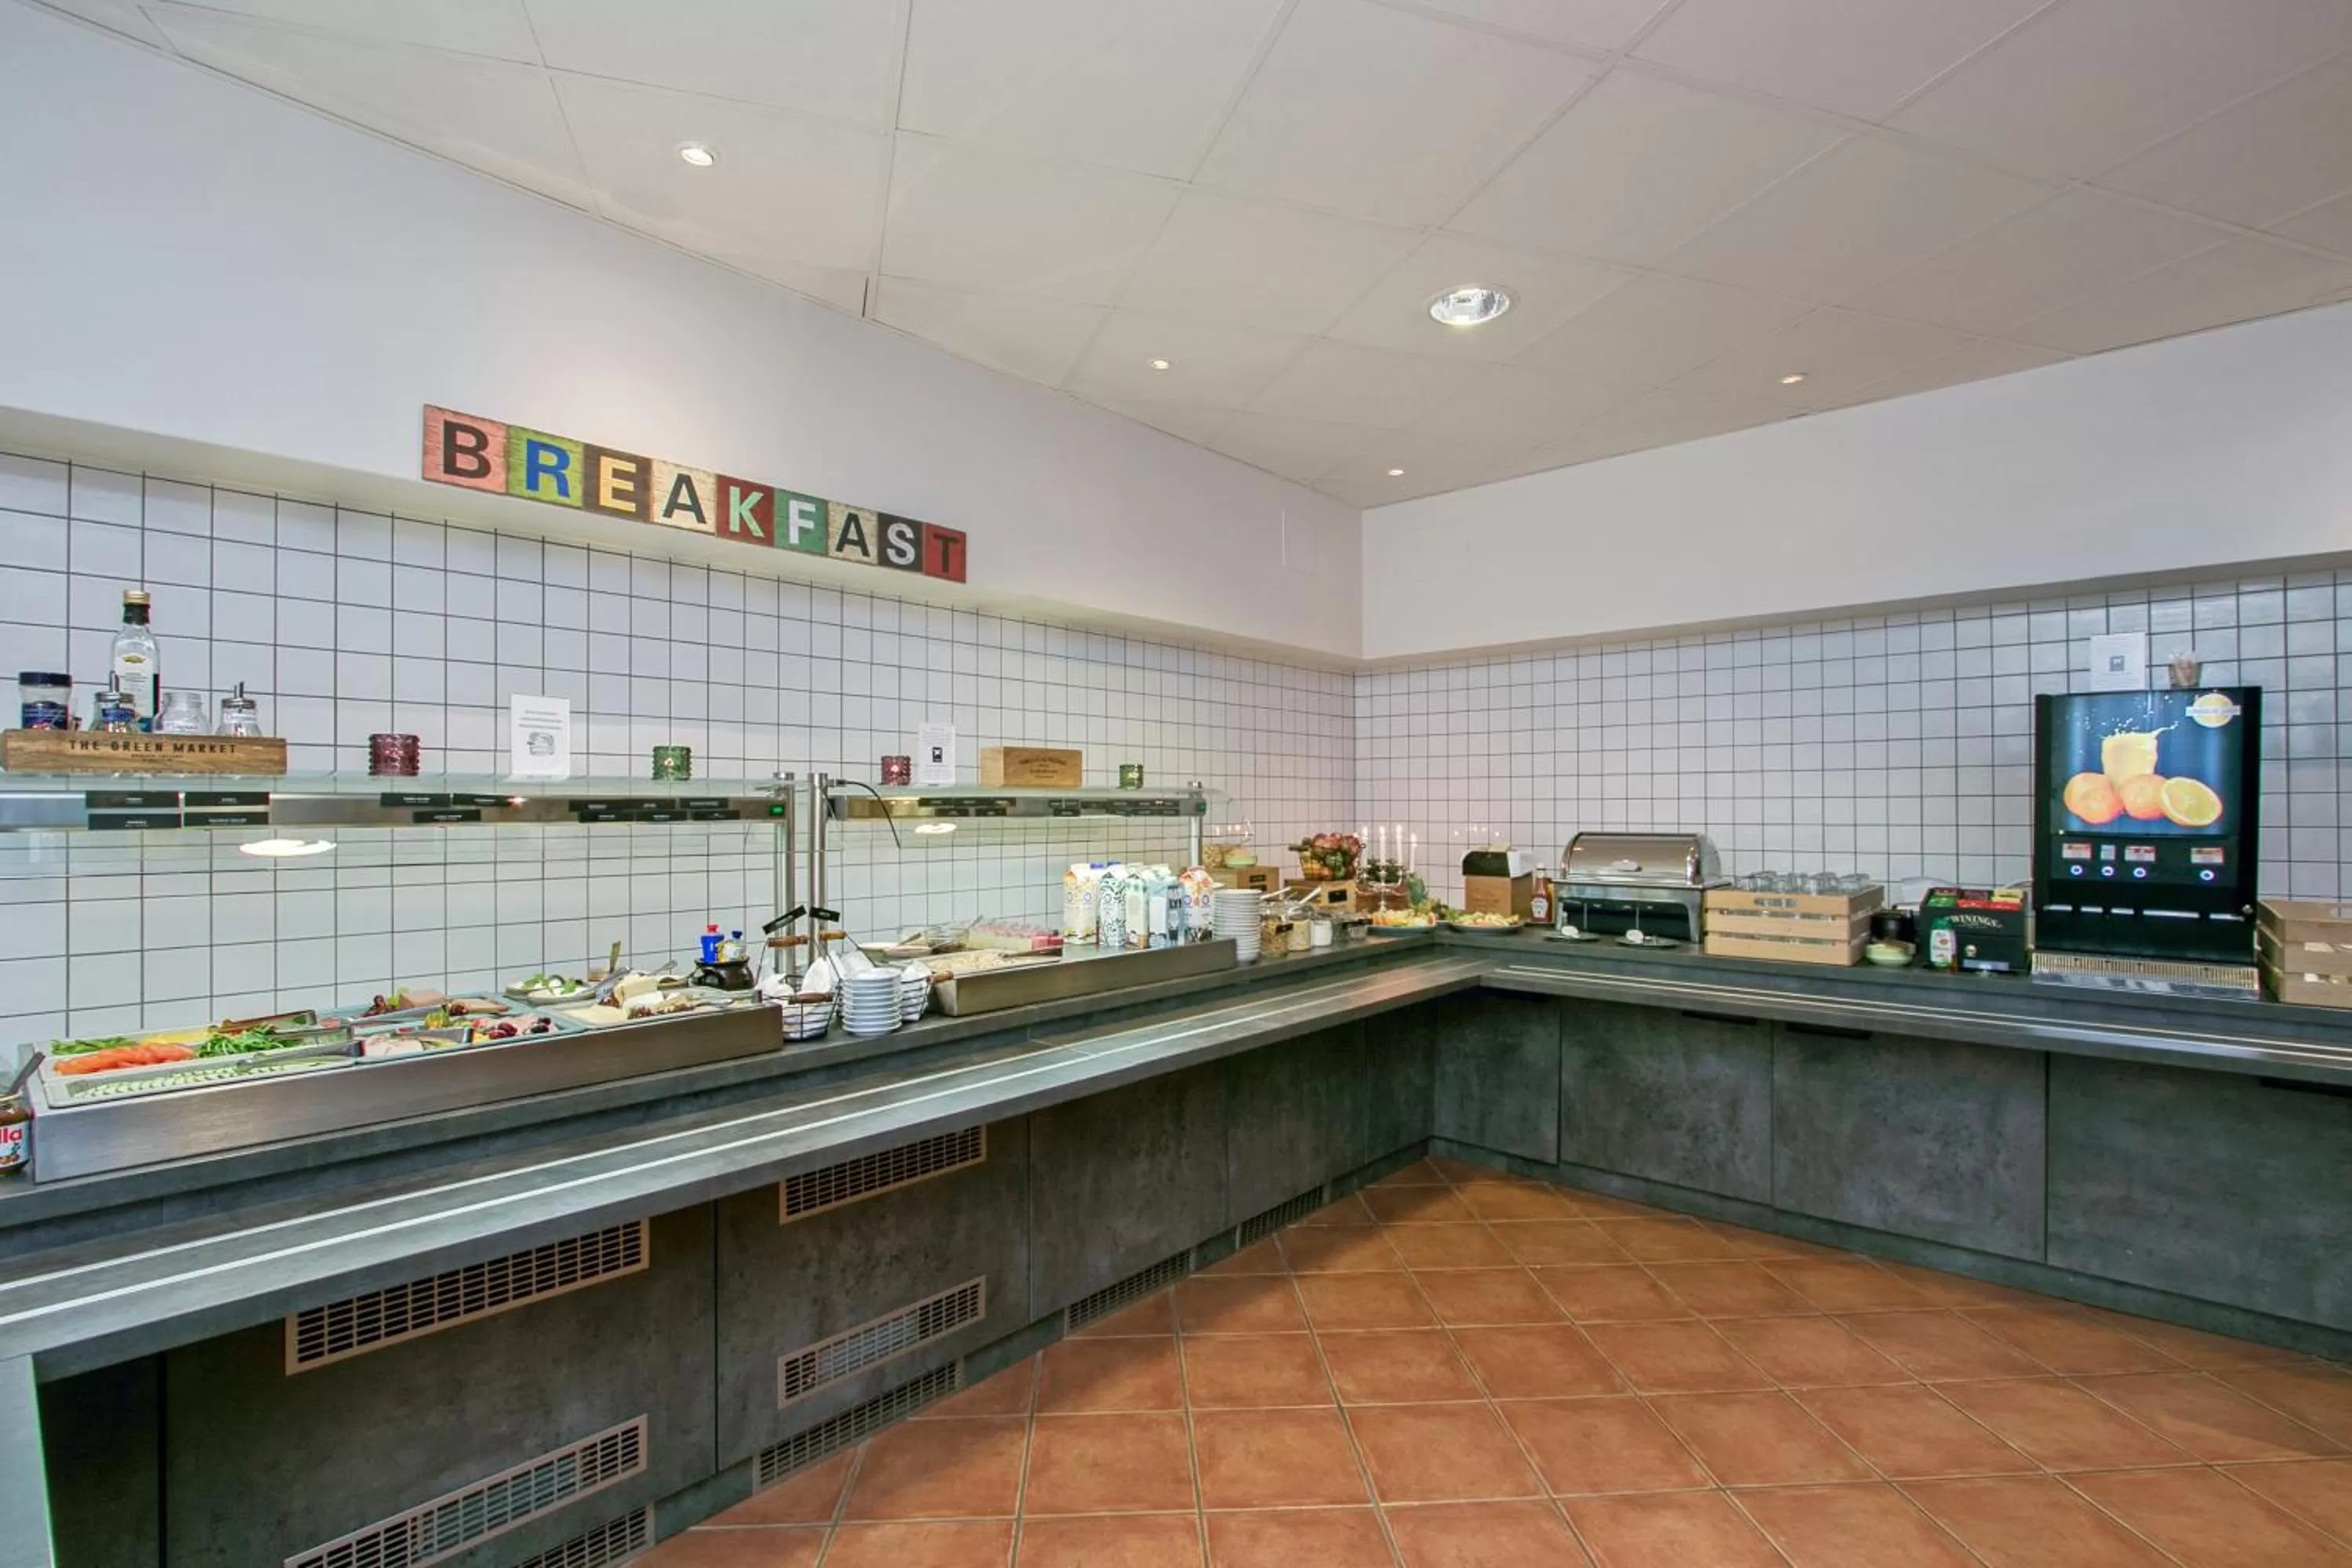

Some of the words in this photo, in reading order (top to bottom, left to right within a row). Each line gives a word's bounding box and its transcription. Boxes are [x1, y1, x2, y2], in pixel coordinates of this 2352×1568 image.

[442, 419, 958, 573] BREAKFAST
[69, 739, 100, 750] THE
[173, 742, 236, 753] MARKET
